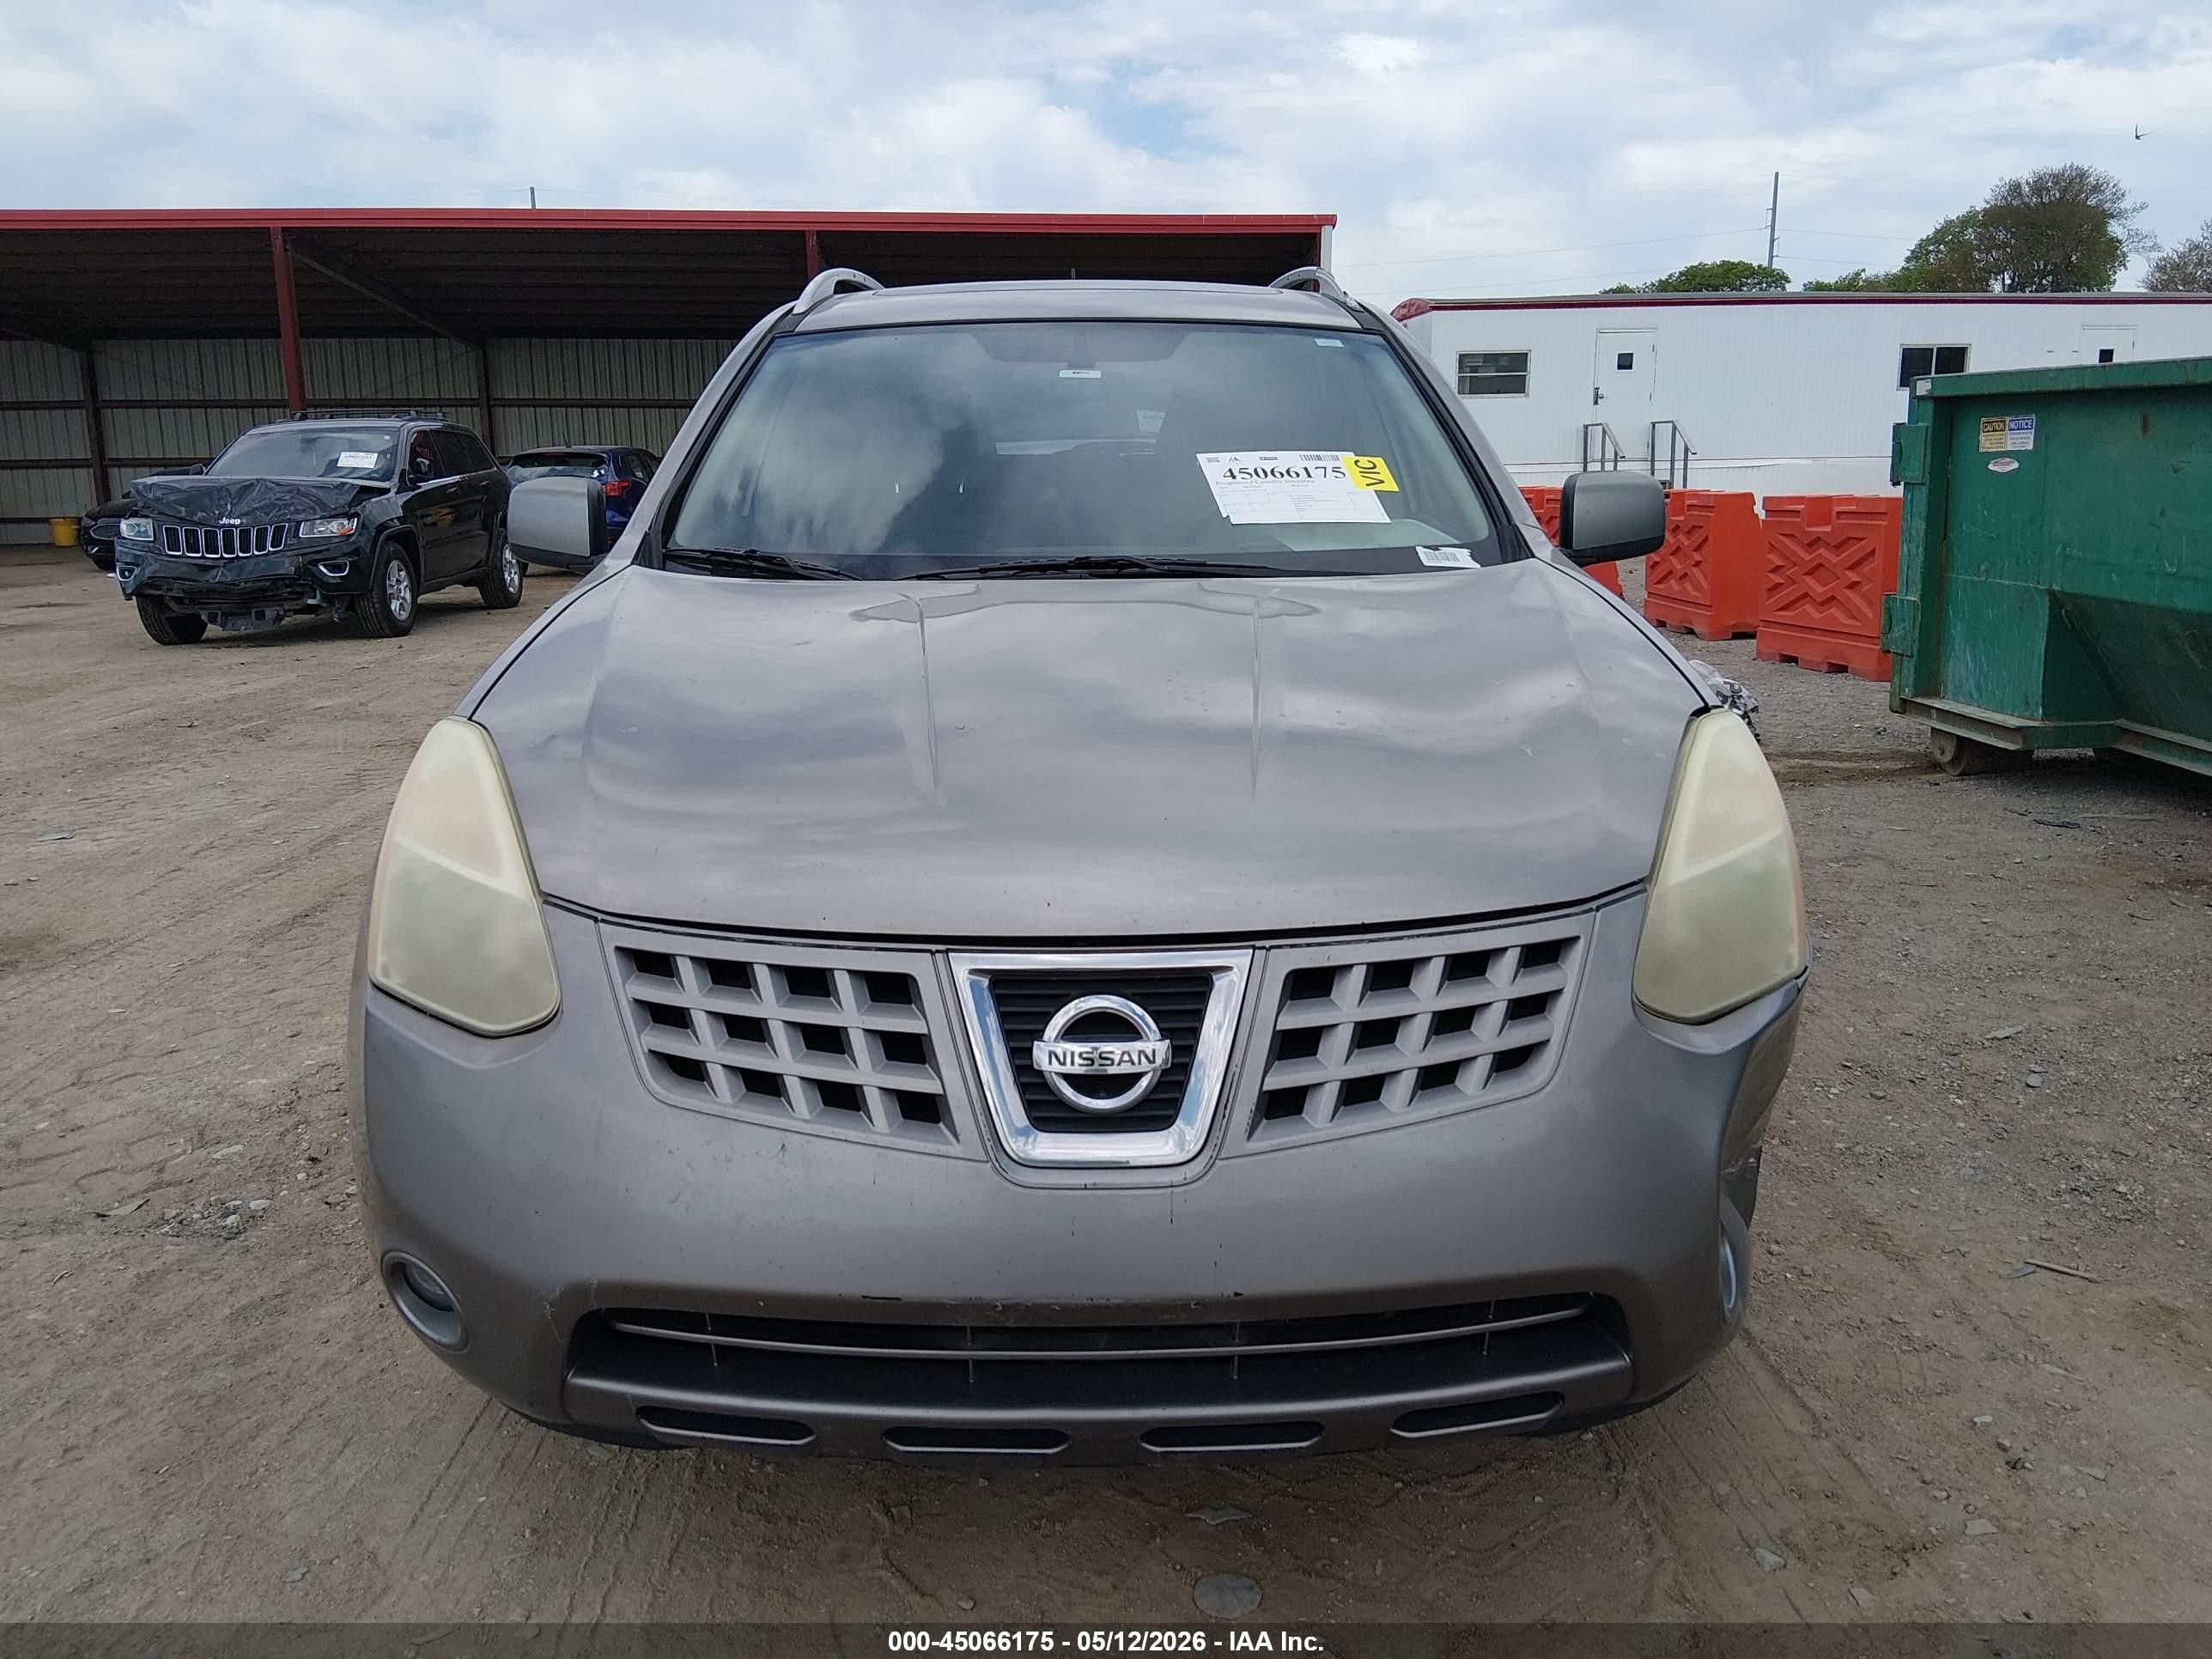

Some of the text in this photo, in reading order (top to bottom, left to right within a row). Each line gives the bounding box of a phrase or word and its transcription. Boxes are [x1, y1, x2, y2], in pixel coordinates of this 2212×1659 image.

[1983, 421, 2006, 432] CAUTION
[2009, 419, 2033, 430] NOTICE
[1223, 465, 1346, 480] 45066175
[1353, 459, 1385, 487] VIC
[219, 516, 241, 526] Jeep
[1048, 1048, 1157, 1067] NISSAN
